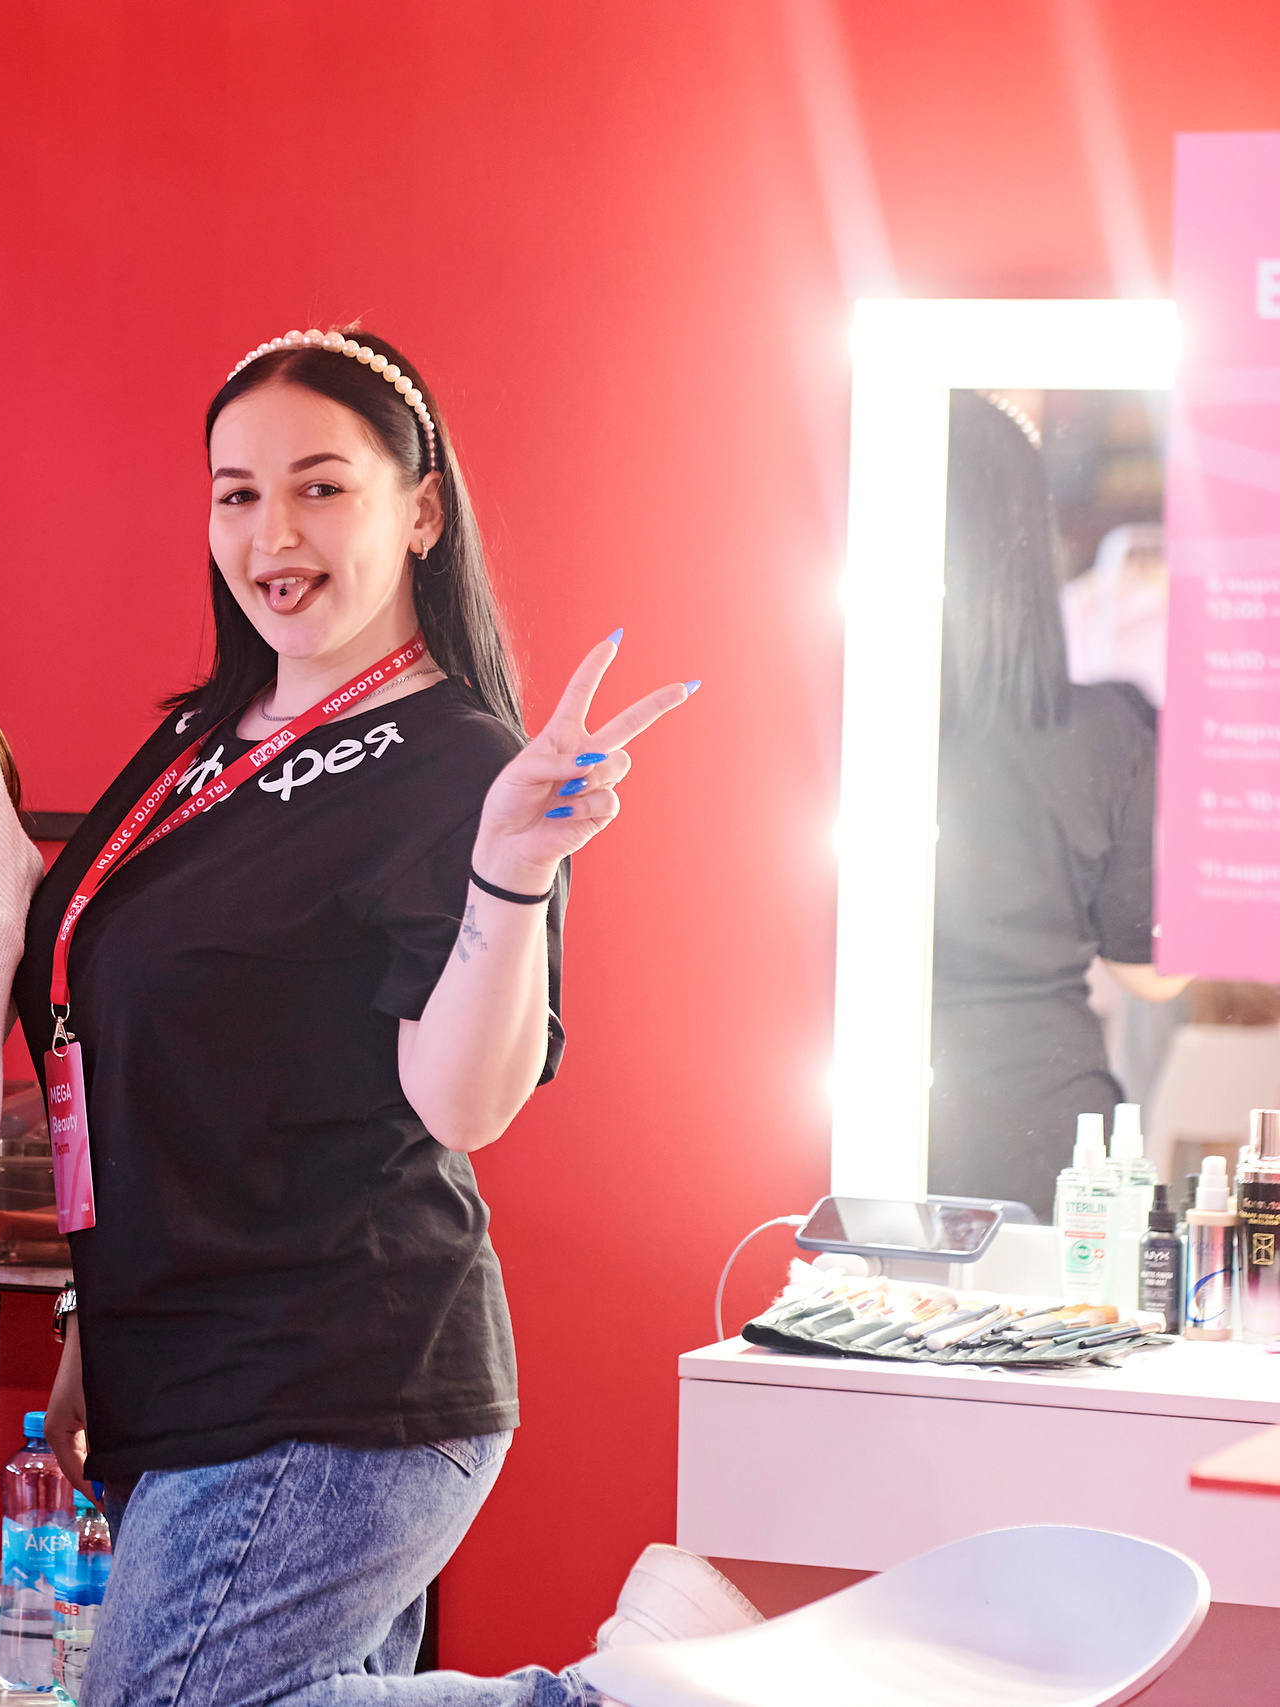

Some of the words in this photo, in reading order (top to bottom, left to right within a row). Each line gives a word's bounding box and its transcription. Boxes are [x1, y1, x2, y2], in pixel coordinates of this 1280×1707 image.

[322, 670, 384, 714] красота
[392, 650, 414, 668] это
[134, 769, 178, 822] красота
[181, 798, 206, 819] это
[206, 780, 228, 799] ты
[111, 829, 132, 852] это
[96, 852, 114, 869] ты
[50, 1083, 72, 1105] MEGA
[52, 1113, 78, 1134] Beauty
[54, 1142, 70, 1156] Team
[1065, 1202, 1107, 1214] STERILIN
